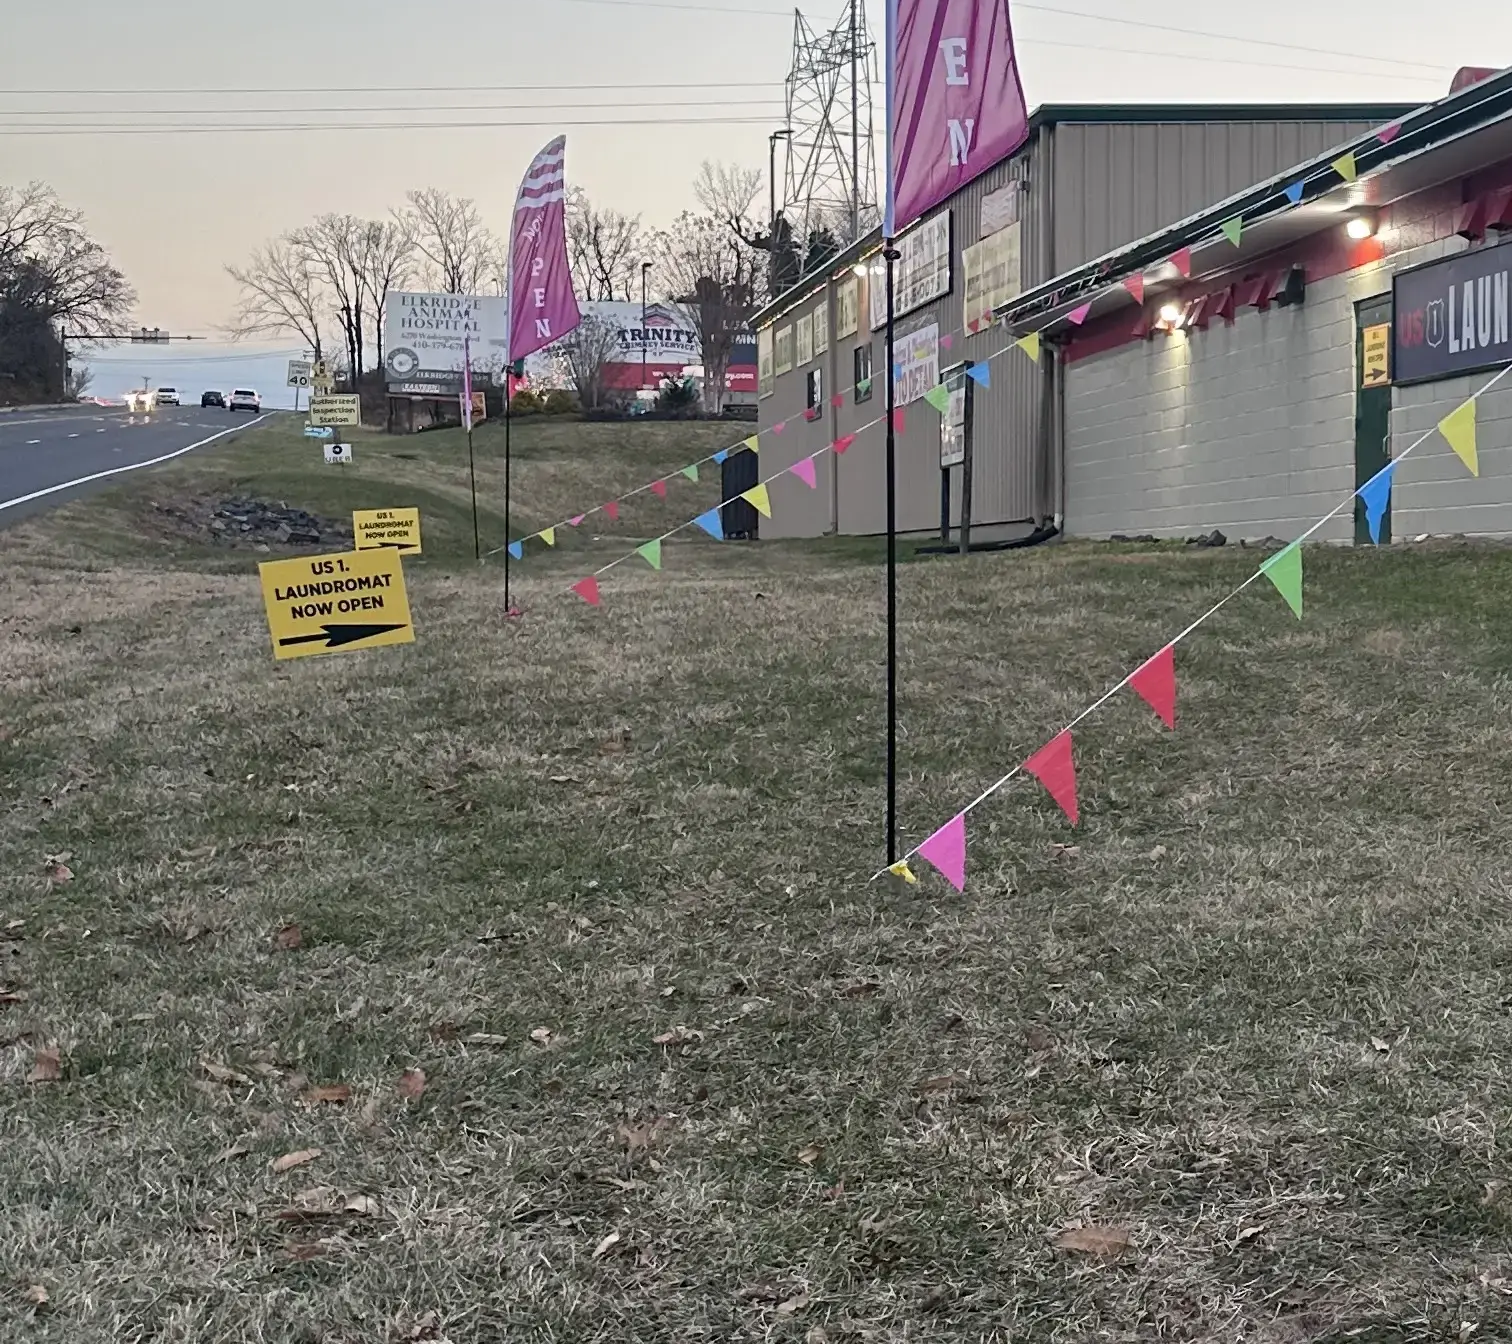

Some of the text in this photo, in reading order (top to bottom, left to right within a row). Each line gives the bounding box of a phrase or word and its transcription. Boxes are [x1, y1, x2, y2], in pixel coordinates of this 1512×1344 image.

[401, 296, 482, 311] ELKRIDGE
[407, 307, 476, 321] ANIMAL
[401, 317, 482, 333] HOSPITAL
[1399, 308, 1424, 349] US
[617, 328, 697, 343] TRINITY
[618, 342, 696, 352] CHIMNEY SERVICE
[289, 376, 308, 386] 40
[311, 397, 356, 405] Authorized
[312, 408, 356, 416] Inspection
[376, 512, 388, 520] US
[358, 519, 414, 530] LAUNDROMAT
[365, 529, 409, 539] NOW OPEN
[311, 559, 350, 575] US 1.
[274, 573, 393, 601] LAUNDROMAT
[291, 595, 384, 619] NOW OPEN
